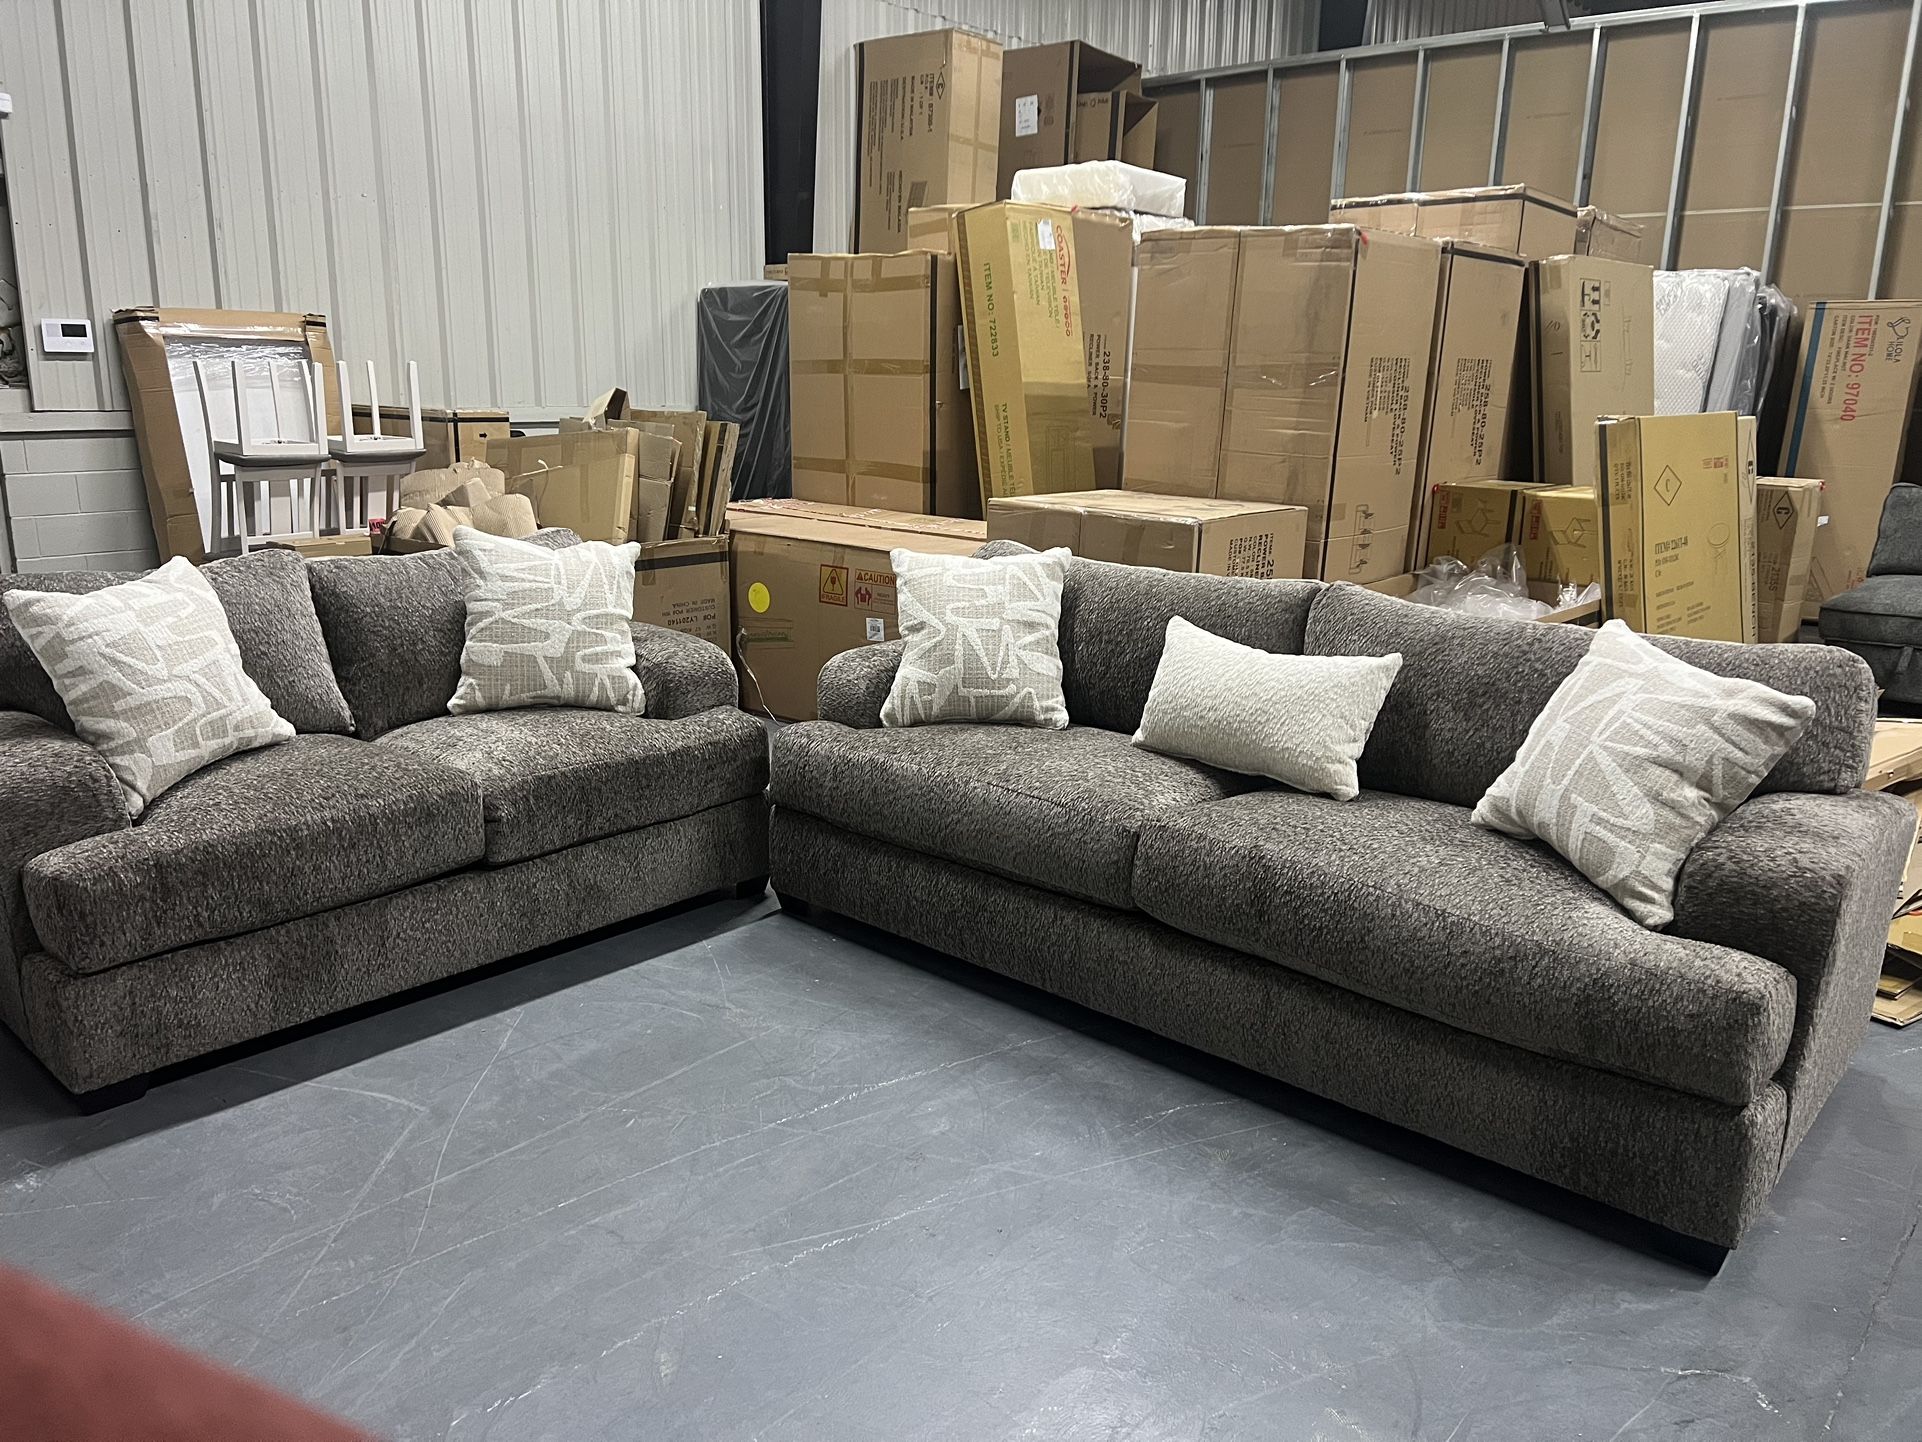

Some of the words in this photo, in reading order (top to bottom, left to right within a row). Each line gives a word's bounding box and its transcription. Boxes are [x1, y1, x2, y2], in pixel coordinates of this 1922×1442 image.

[1056, 225, 1067, 285] COASTER
[983, 262, 993, 291] ITEM
[986, 294, 995, 315] NO:
[1831, 315, 1839, 336] CARTON
[1854, 314, 1873, 349] ITEM
[1833, 346, 1841, 374] FIREPLACE
[1886, 341, 1894, 362] HOME
[1893, 337, 1903, 364] LILOLA
[1848, 352, 1865, 379] NO:
[1002, 403, 1008, 413] TV
[1840, 382, 1860, 422] 97040
[1002, 415, 1010, 442] STAND
[1005, 448, 1014, 480] MEUBLE
[1776, 507, 1790, 515] C
[863, 572, 895, 586] CAUTION
[686, 604, 715, 613] CUSTOMER
[821, 593, 845, 603] FRAGILE
